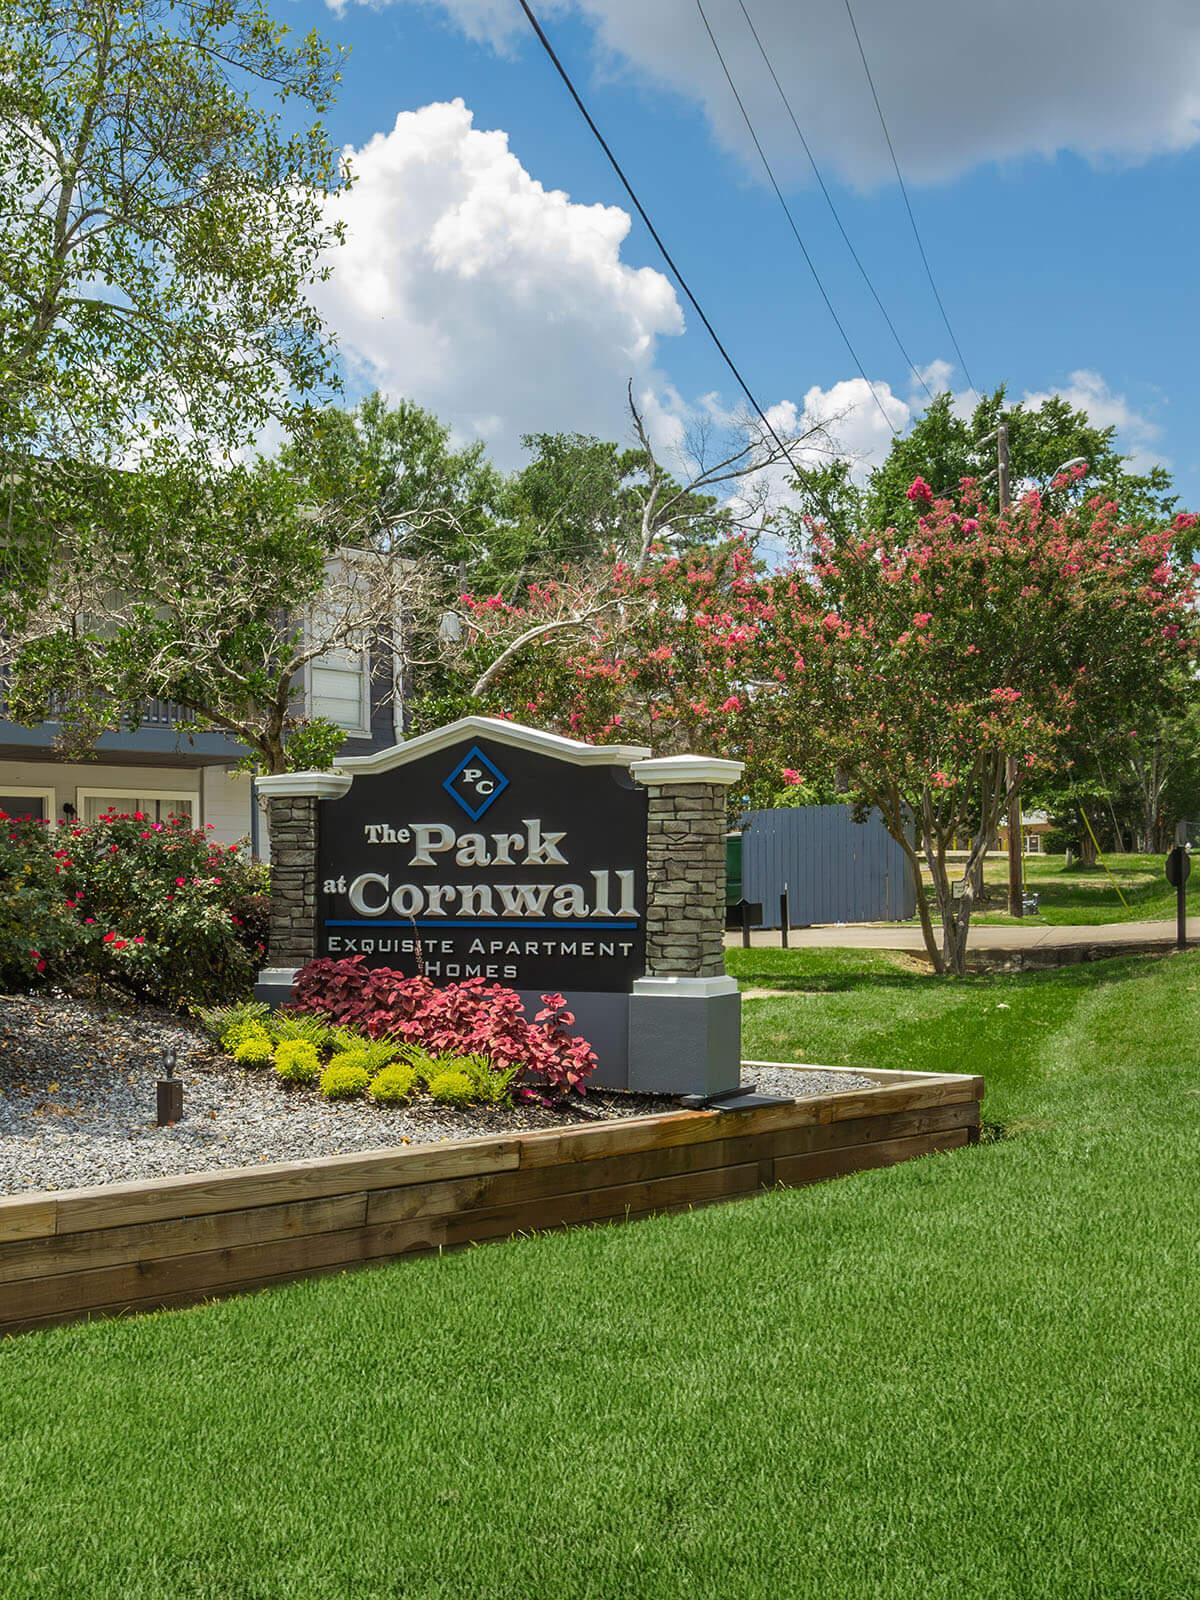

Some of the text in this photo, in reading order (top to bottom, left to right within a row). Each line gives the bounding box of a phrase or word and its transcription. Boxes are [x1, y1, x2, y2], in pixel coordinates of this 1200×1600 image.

[364, 819, 569, 867] The Park
[323, 870, 640, 918] at Cornwall
[468, 938, 633, 956] APARTMENT
[424, 961, 517, 978] HOMES
